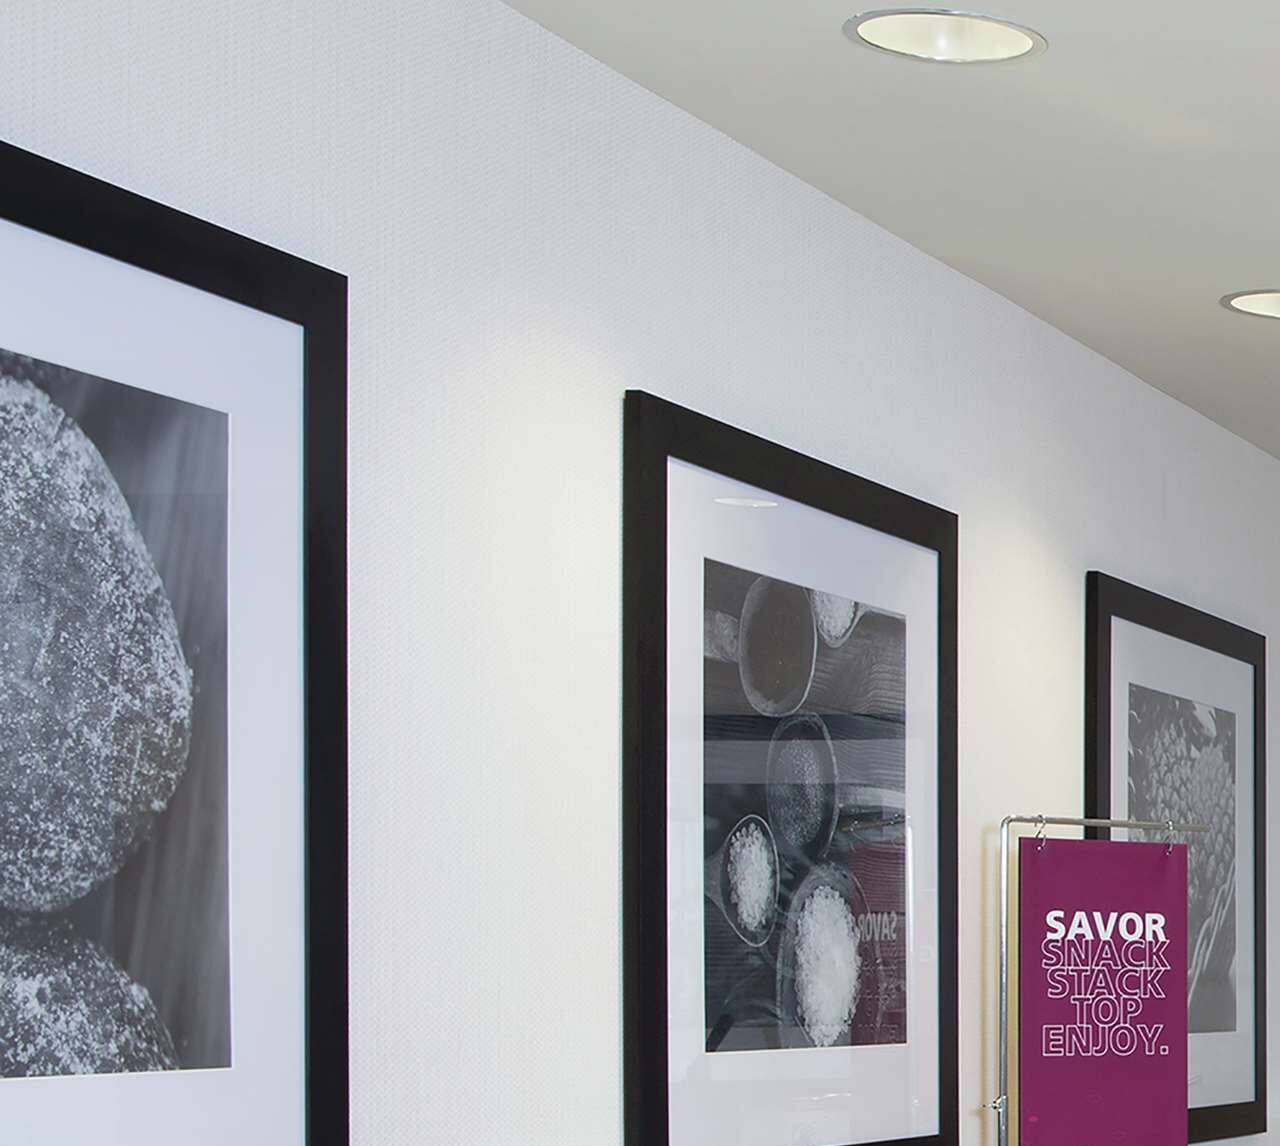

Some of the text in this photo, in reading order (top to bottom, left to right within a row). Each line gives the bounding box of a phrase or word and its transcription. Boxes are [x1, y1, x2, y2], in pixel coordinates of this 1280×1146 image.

[1046, 911, 1167, 941] SAVOR
[1042, 938, 1171, 969] SNACK
[1047, 967, 1166, 998] STACK
[1071, 996, 1143, 1027] TOP
[1042, 1024, 1169, 1056] ENJOY.
